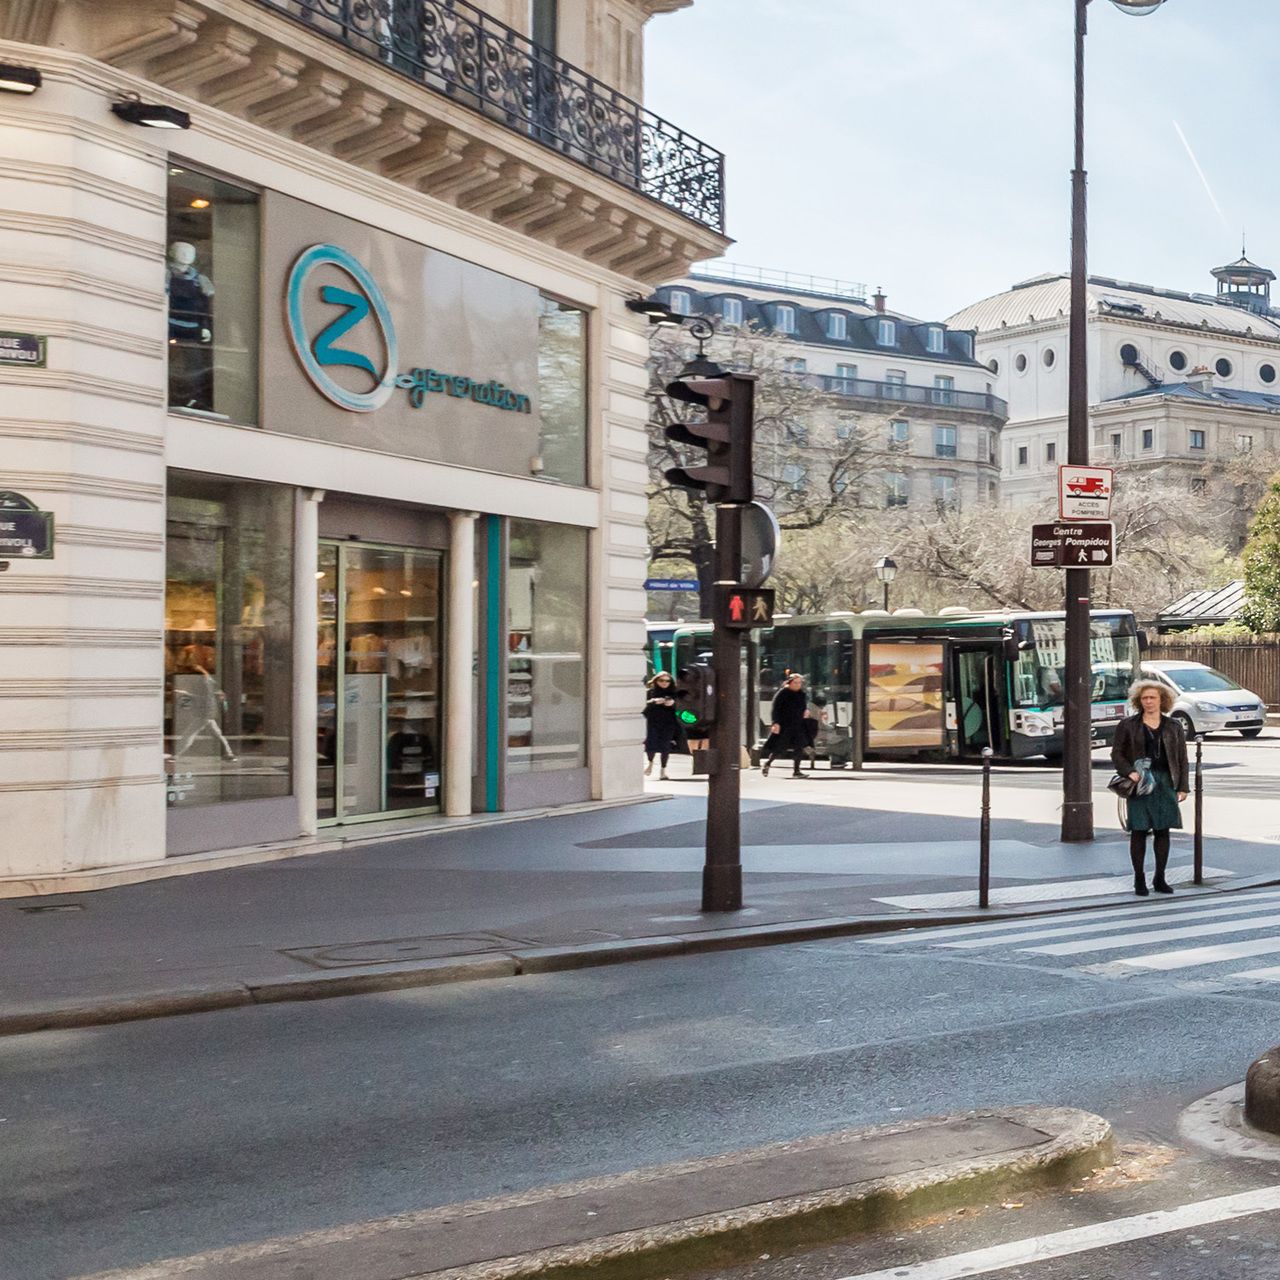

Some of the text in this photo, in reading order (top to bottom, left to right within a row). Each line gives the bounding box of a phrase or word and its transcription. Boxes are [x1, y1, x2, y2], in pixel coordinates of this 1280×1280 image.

[409, 368, 532, 414] generation
[1053, 527, 1083, 536] Centre
[1033, 537, 1110, 548] Georges Pompidou
